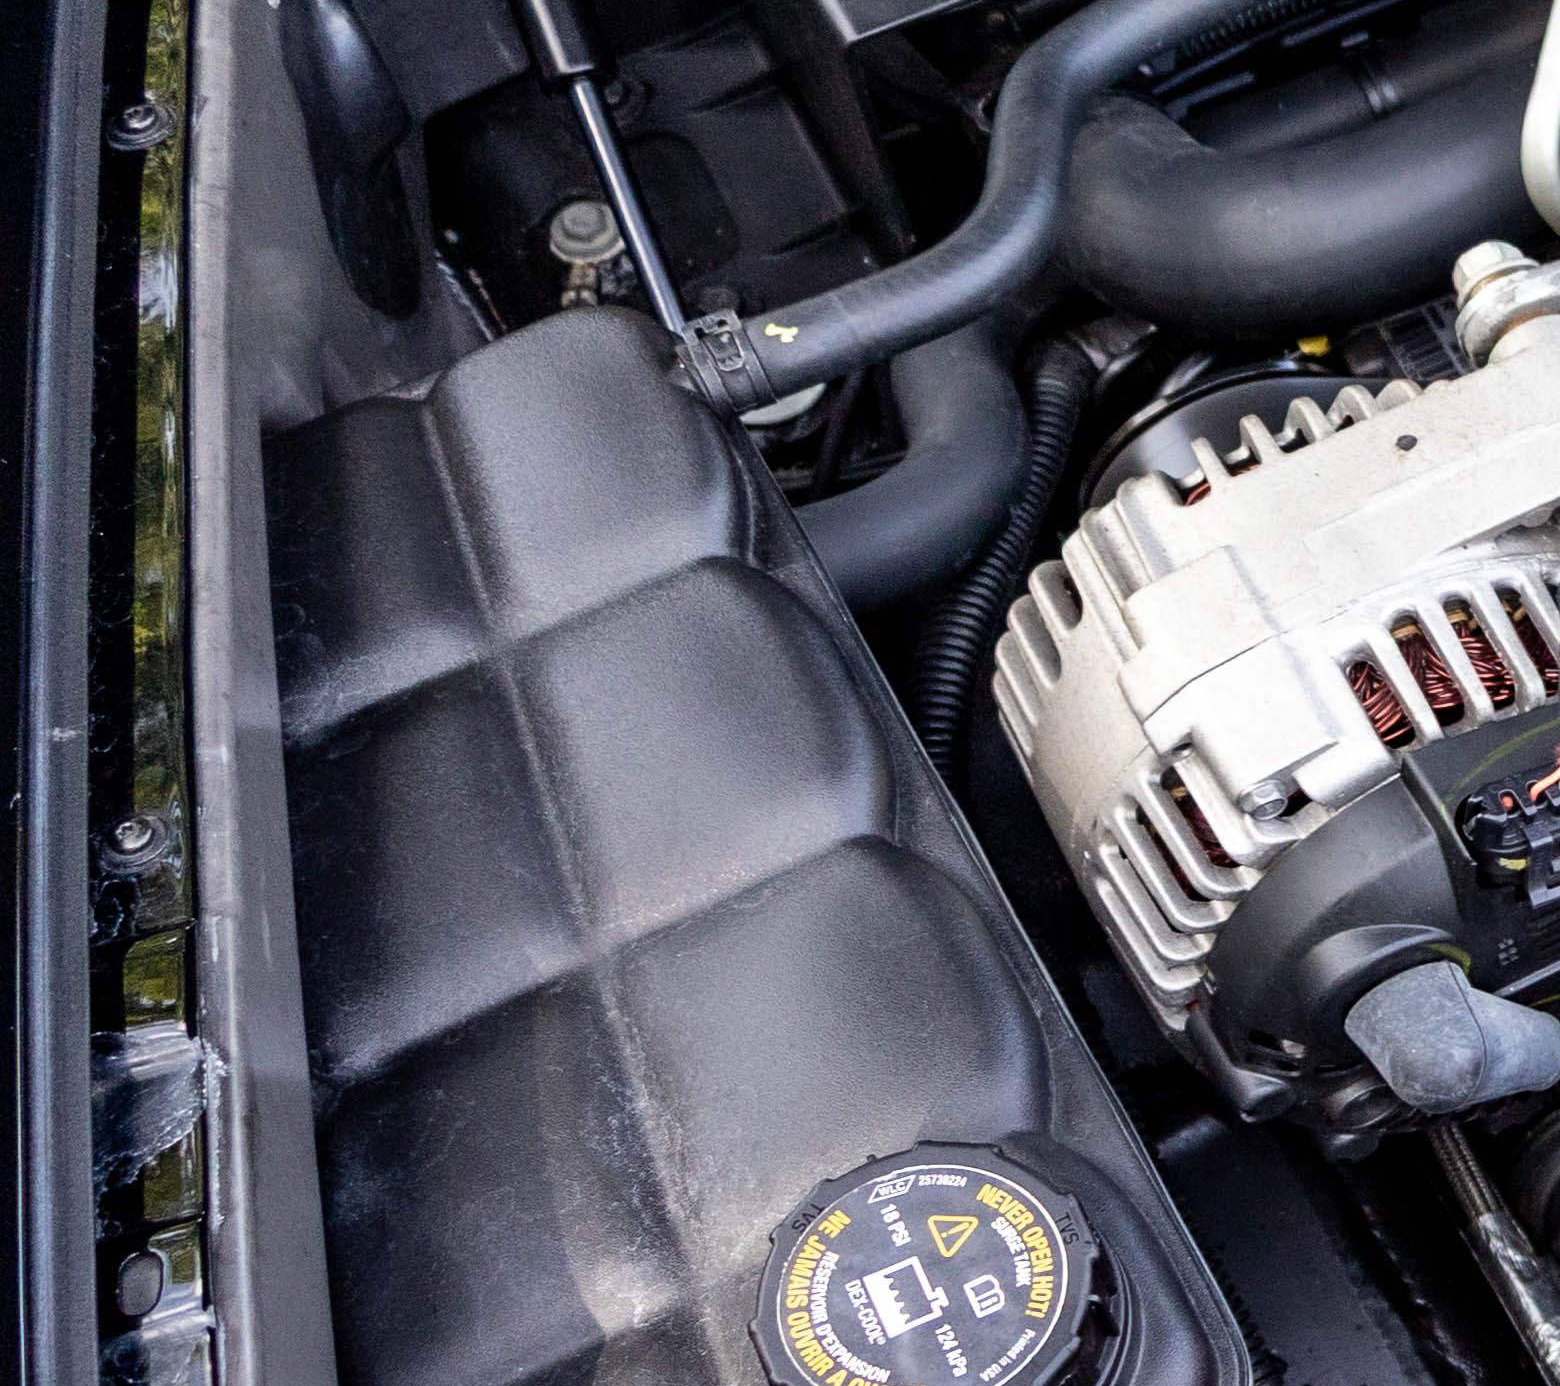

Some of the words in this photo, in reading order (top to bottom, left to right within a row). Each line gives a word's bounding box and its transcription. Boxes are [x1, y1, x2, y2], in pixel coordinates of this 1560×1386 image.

[878, 1181, 907, 1197] WLC
[880, 1203, 900, 1223] 18
[975, 1182, 1035, 1231] NEVER
[817, 1209, 852, 1238] NE
[888, 1220, 912, 1247] PSI
[1055, 1211, 1080, 1245] TVS
[990, 1216, 1027, 1255] SURGE
[1013, 1251, 1032, 1288] TANK
[1022, 1225, 1054, 1274] OPEN
[785, 1234, 827, 1309] JAMAIS
[1024, 1275, 1054, 1319] HOT!
[786, 1311, 835, 1377] OUVRIR
[815, 1323, 892, 1383] D'EXPANSION
[935, 1324, 960, 1351] 124
[1006, 1328, 1037, 1360] Printed
[946, 1348, 968, 1377] kPa
[979, 1362, 1002, 1383] USA
[998, 1354, 1013, 1367] in
